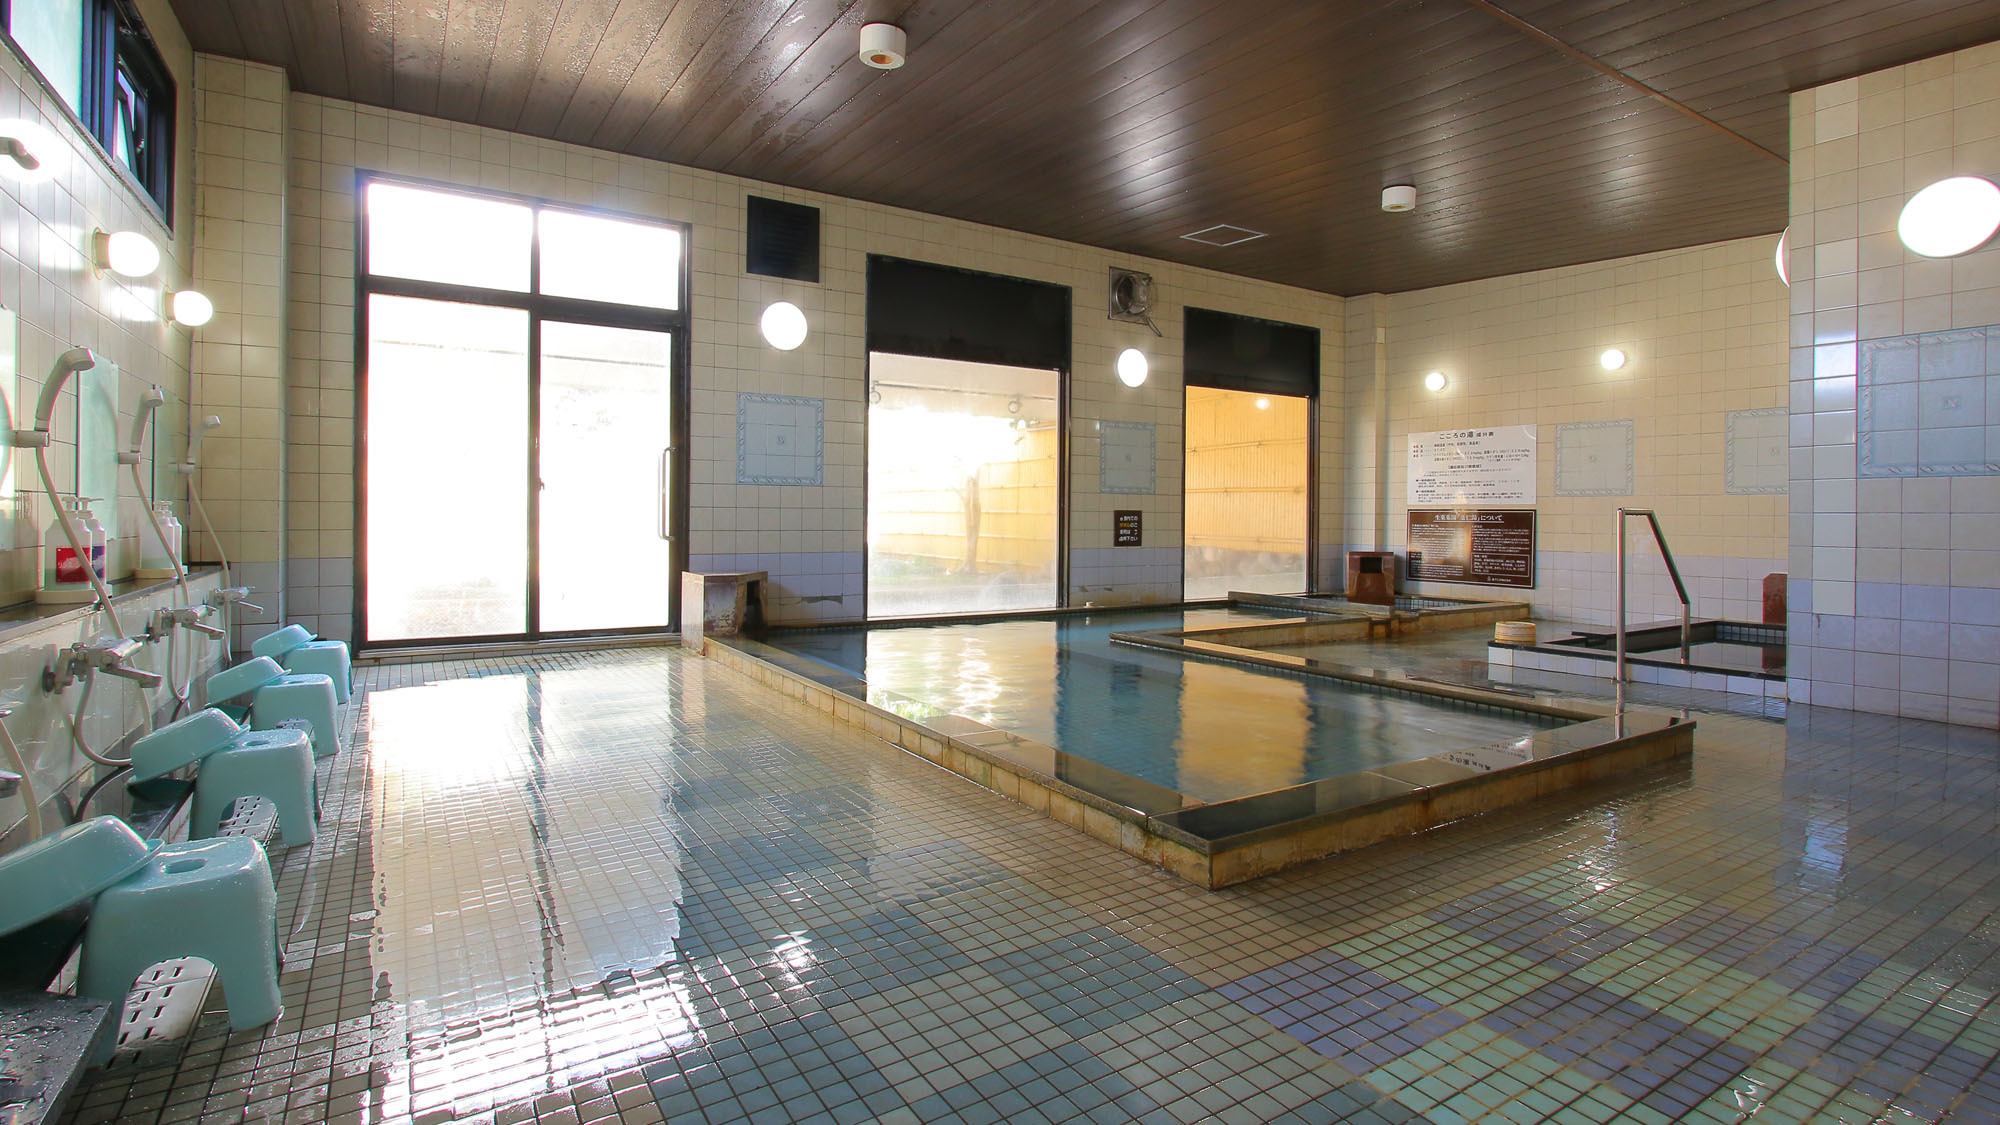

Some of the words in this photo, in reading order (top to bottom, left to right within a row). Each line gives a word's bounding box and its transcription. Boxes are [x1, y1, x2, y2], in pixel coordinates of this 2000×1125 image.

[1439, 431, 1474, 440] こころの湯
